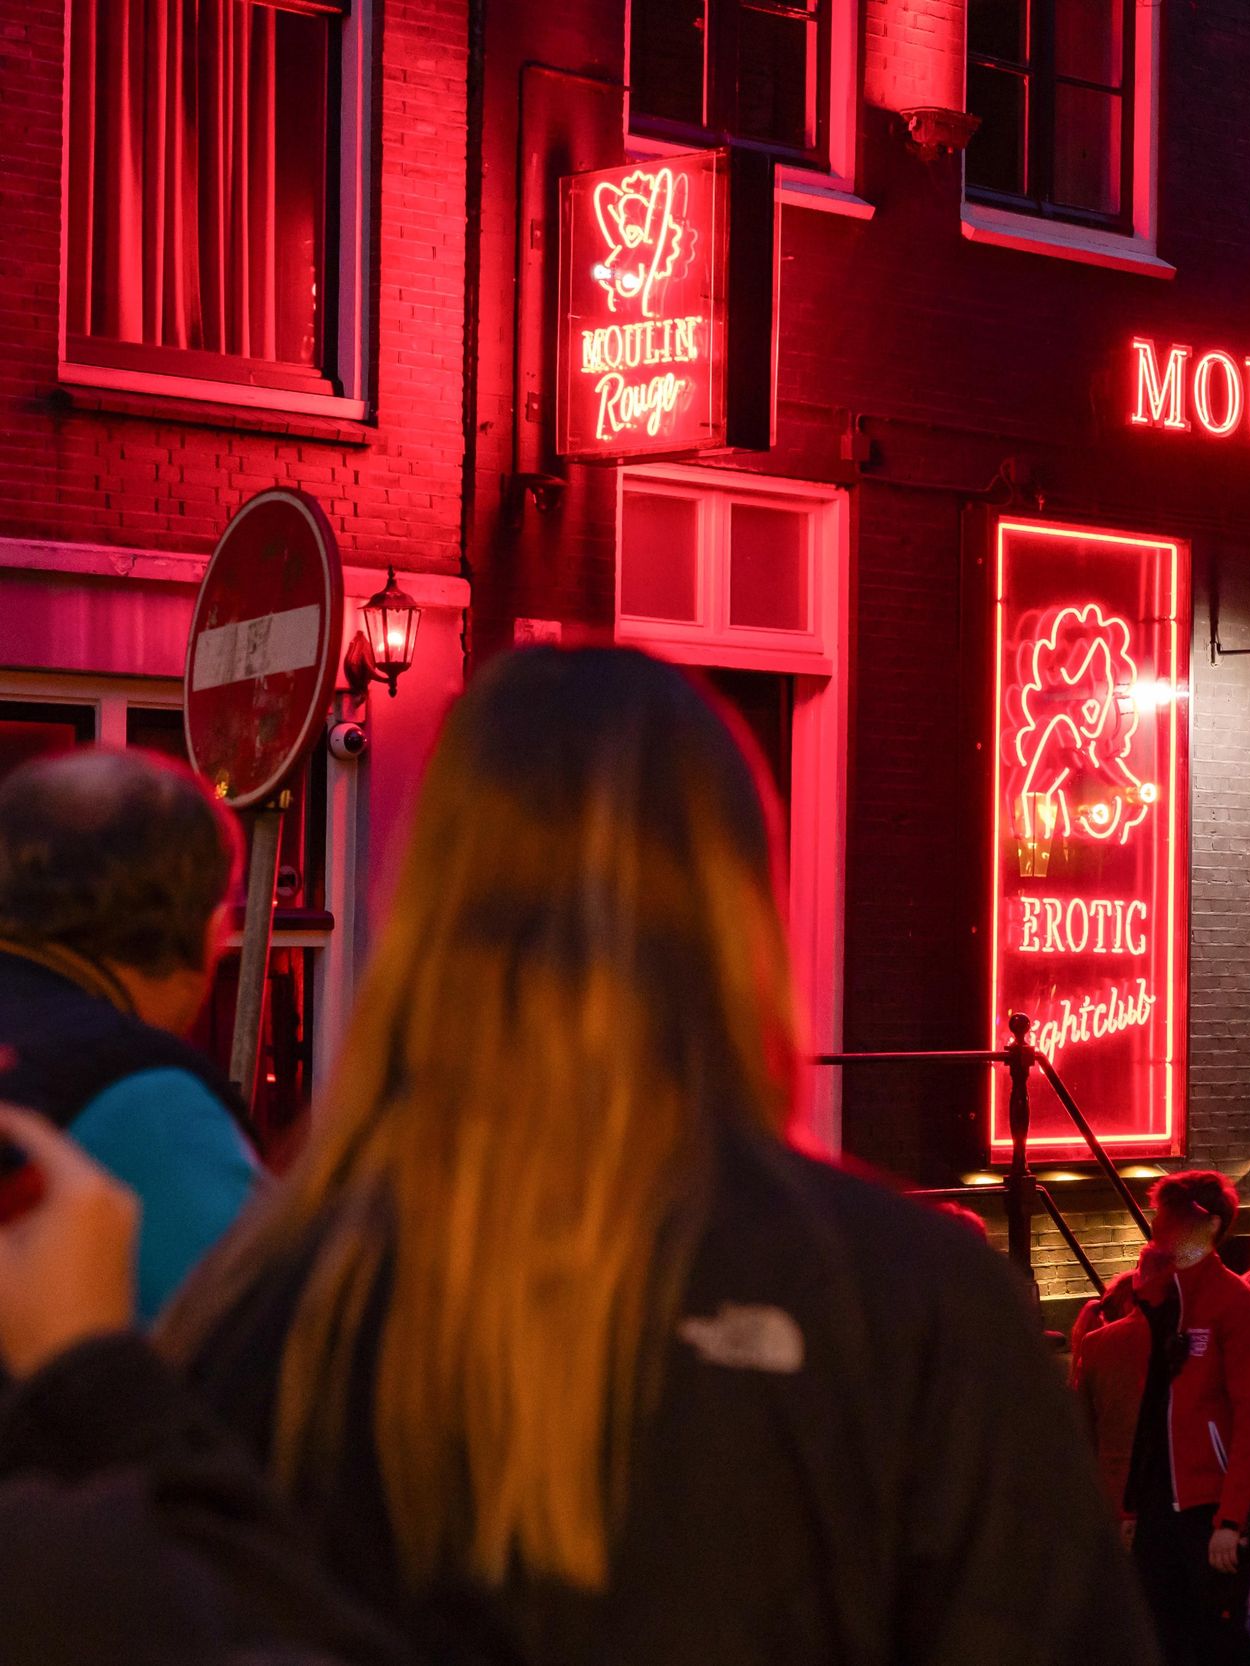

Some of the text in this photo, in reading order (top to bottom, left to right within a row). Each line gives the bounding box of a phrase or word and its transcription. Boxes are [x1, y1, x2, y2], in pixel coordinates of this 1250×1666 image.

[581, 317, 703, 373] MOULIN
[595, 372, 686, 439] Rouge
[1018, 896, 1148, 956] EROTIC
[1009, 977, 1157, 1074] ightclub
